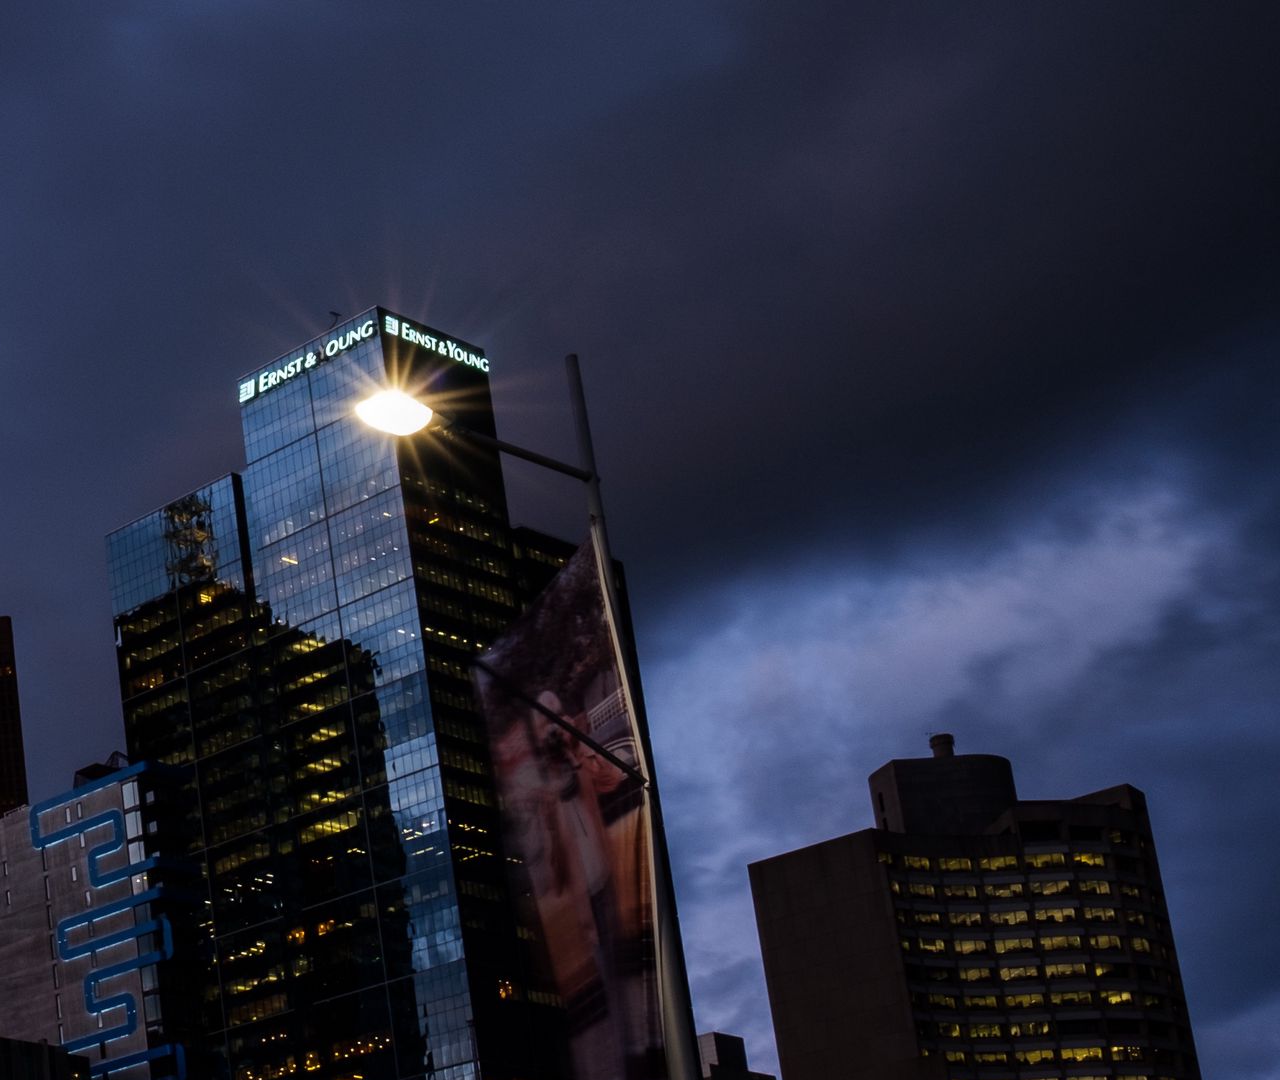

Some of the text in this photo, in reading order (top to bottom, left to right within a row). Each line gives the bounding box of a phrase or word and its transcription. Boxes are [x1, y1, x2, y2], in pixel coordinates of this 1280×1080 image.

[401, 322, 490, 372] ERNST & YOUNG
[258, 356, 304, 393] ERNST
[304, 352, 317, 370] &
